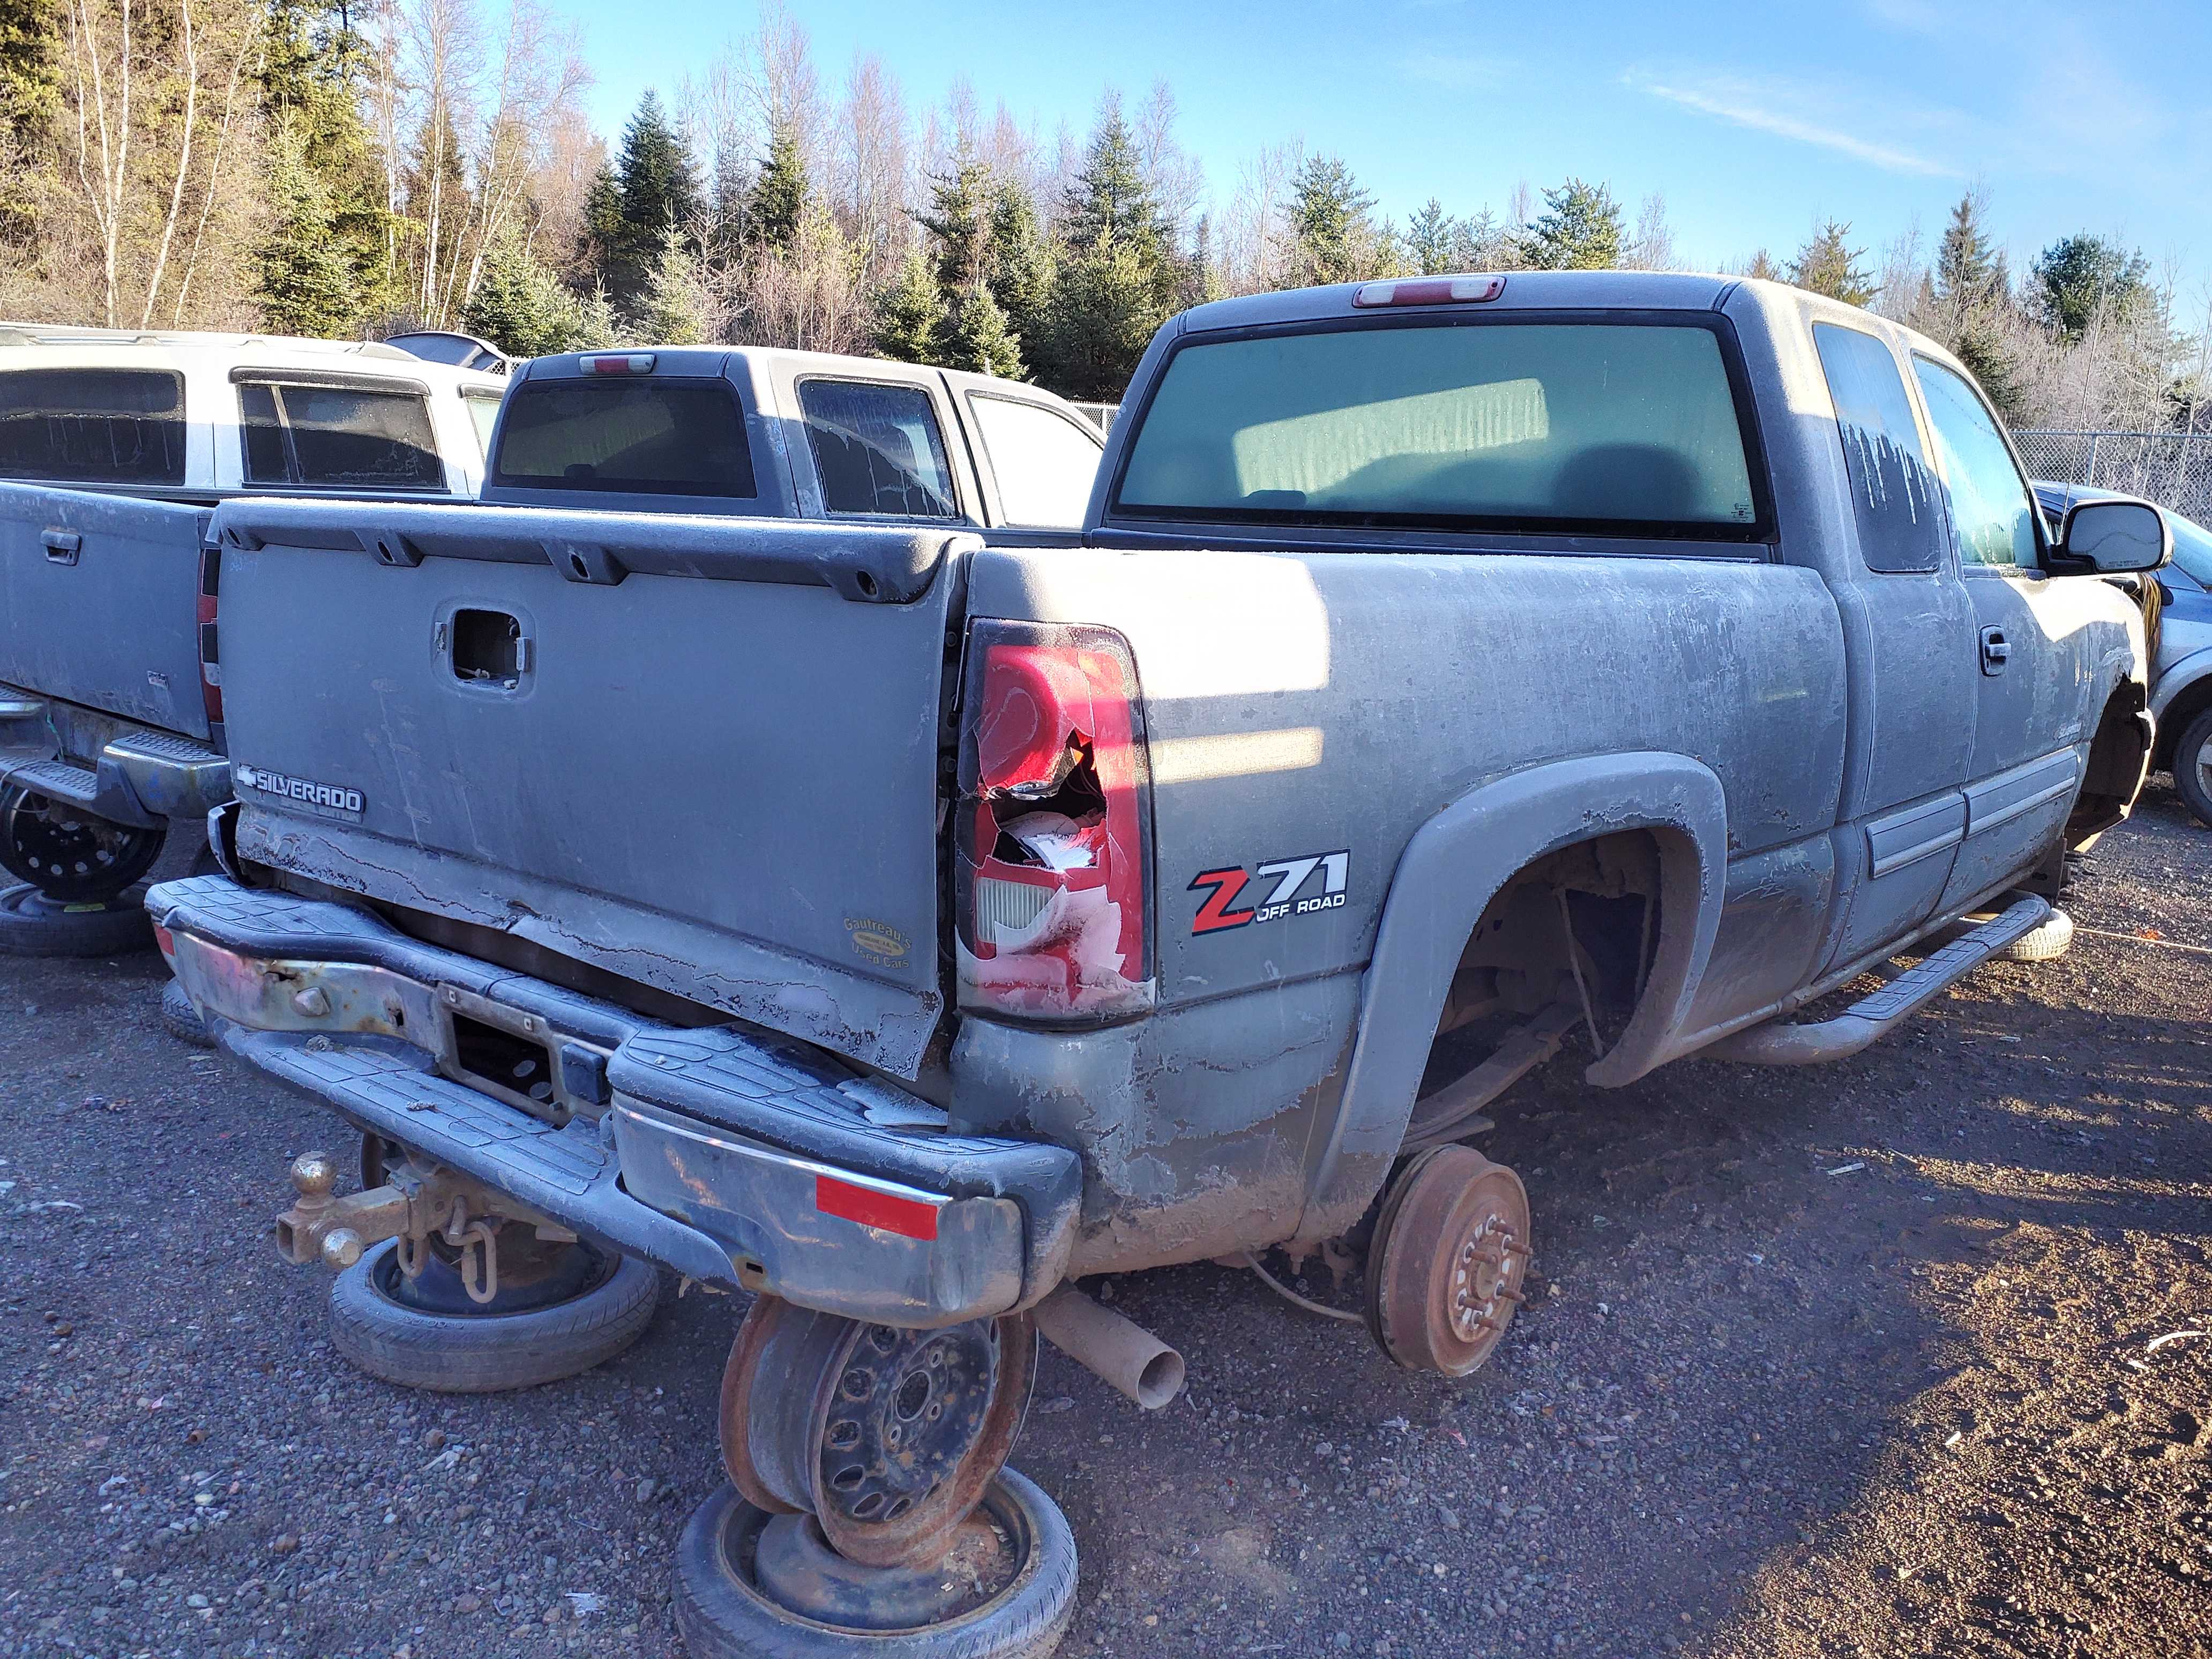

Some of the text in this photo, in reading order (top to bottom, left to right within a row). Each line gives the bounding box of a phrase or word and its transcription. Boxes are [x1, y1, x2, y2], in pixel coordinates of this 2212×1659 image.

[257, 771, 362, 812] SILVERADO
[1186, 848, 1350, 937] Z71
[1256, 894, 1346, 923] OFF ROAD
[844, 917, 911, 949] Gautreau's
[851, 941, 879, 964] Used
[883, 956, 909, 969] Cars
